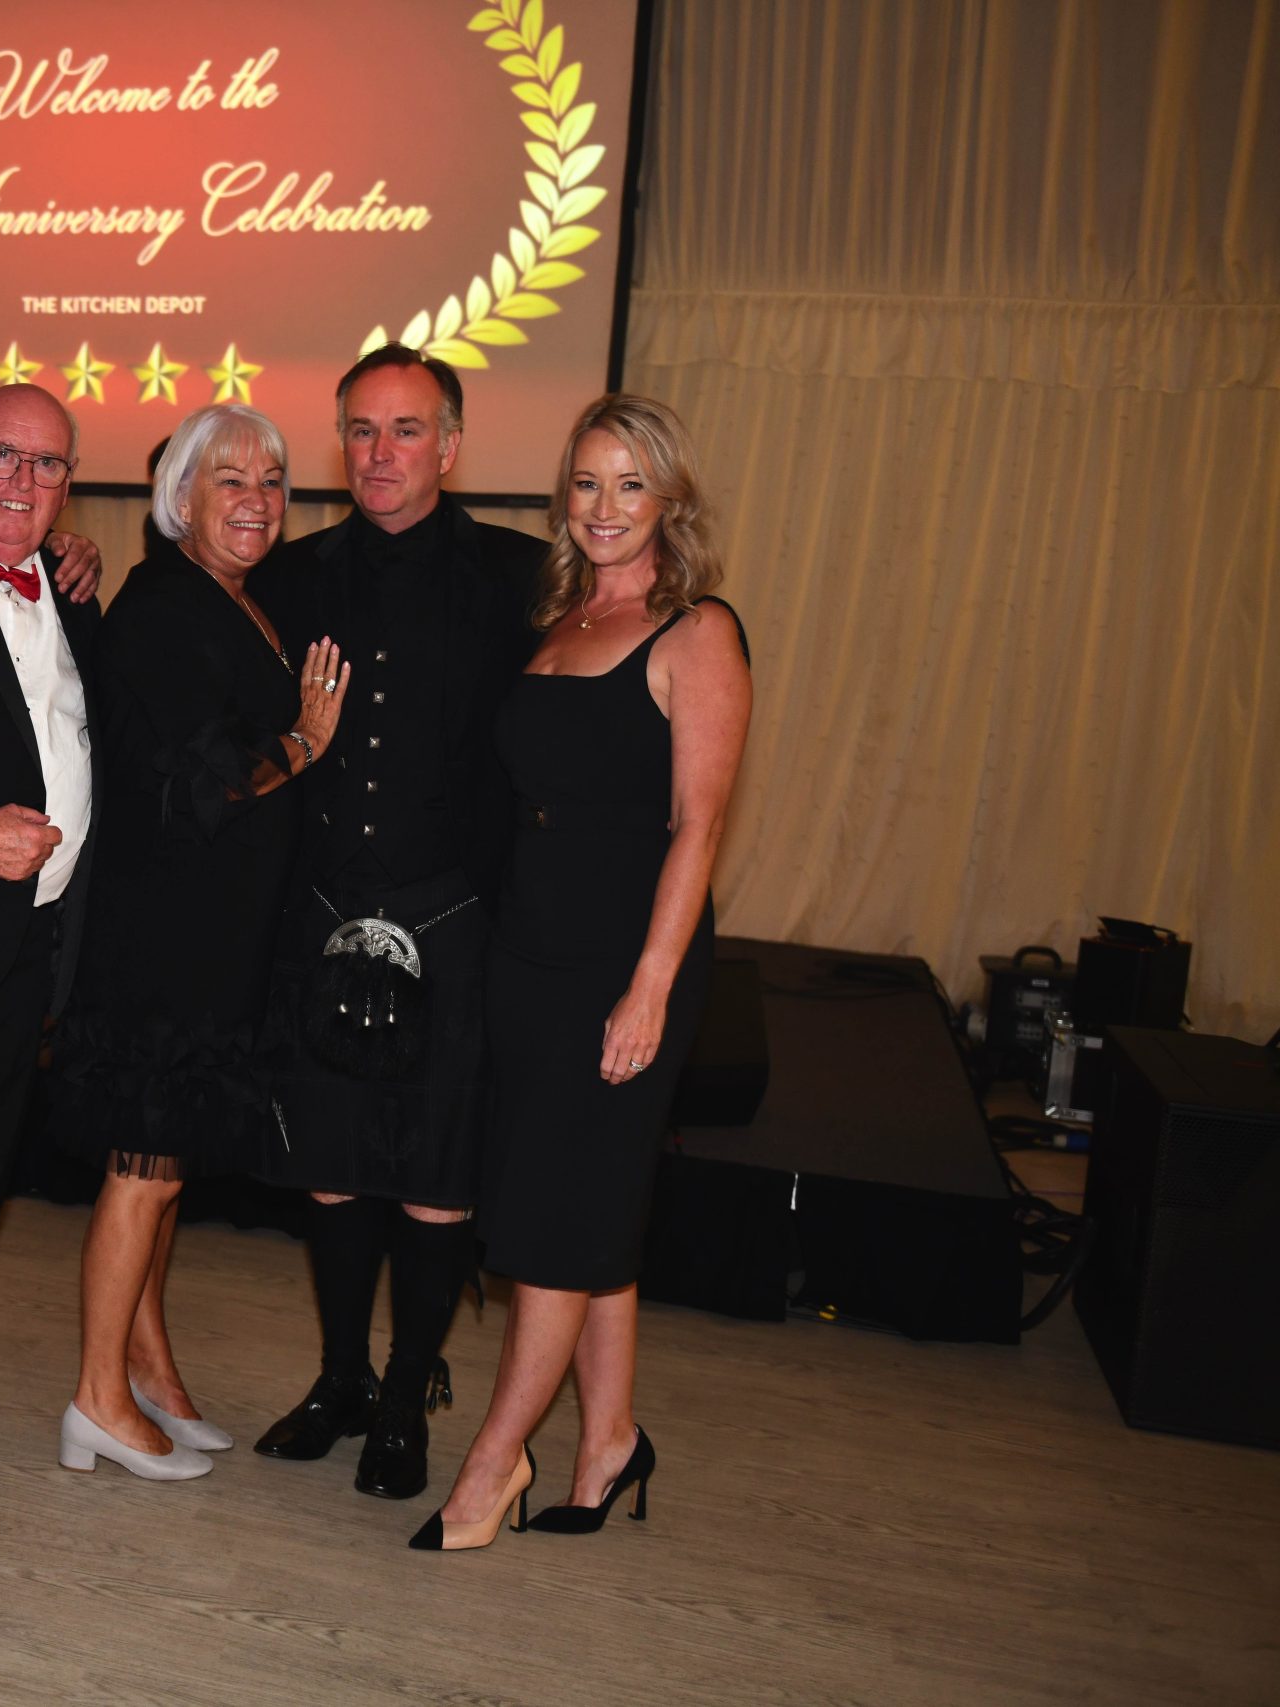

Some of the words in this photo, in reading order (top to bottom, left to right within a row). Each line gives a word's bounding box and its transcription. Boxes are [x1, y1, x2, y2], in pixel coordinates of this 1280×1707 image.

[177, 60, 216, 111] to
[220, 47, 280, 110] the
[201, 161, 432, 237] Celebration
[22, 296, 58, 314] THE
[61, 296, 141, 314] KITCHEN
[145, 296, 206, 314] DEPOT
